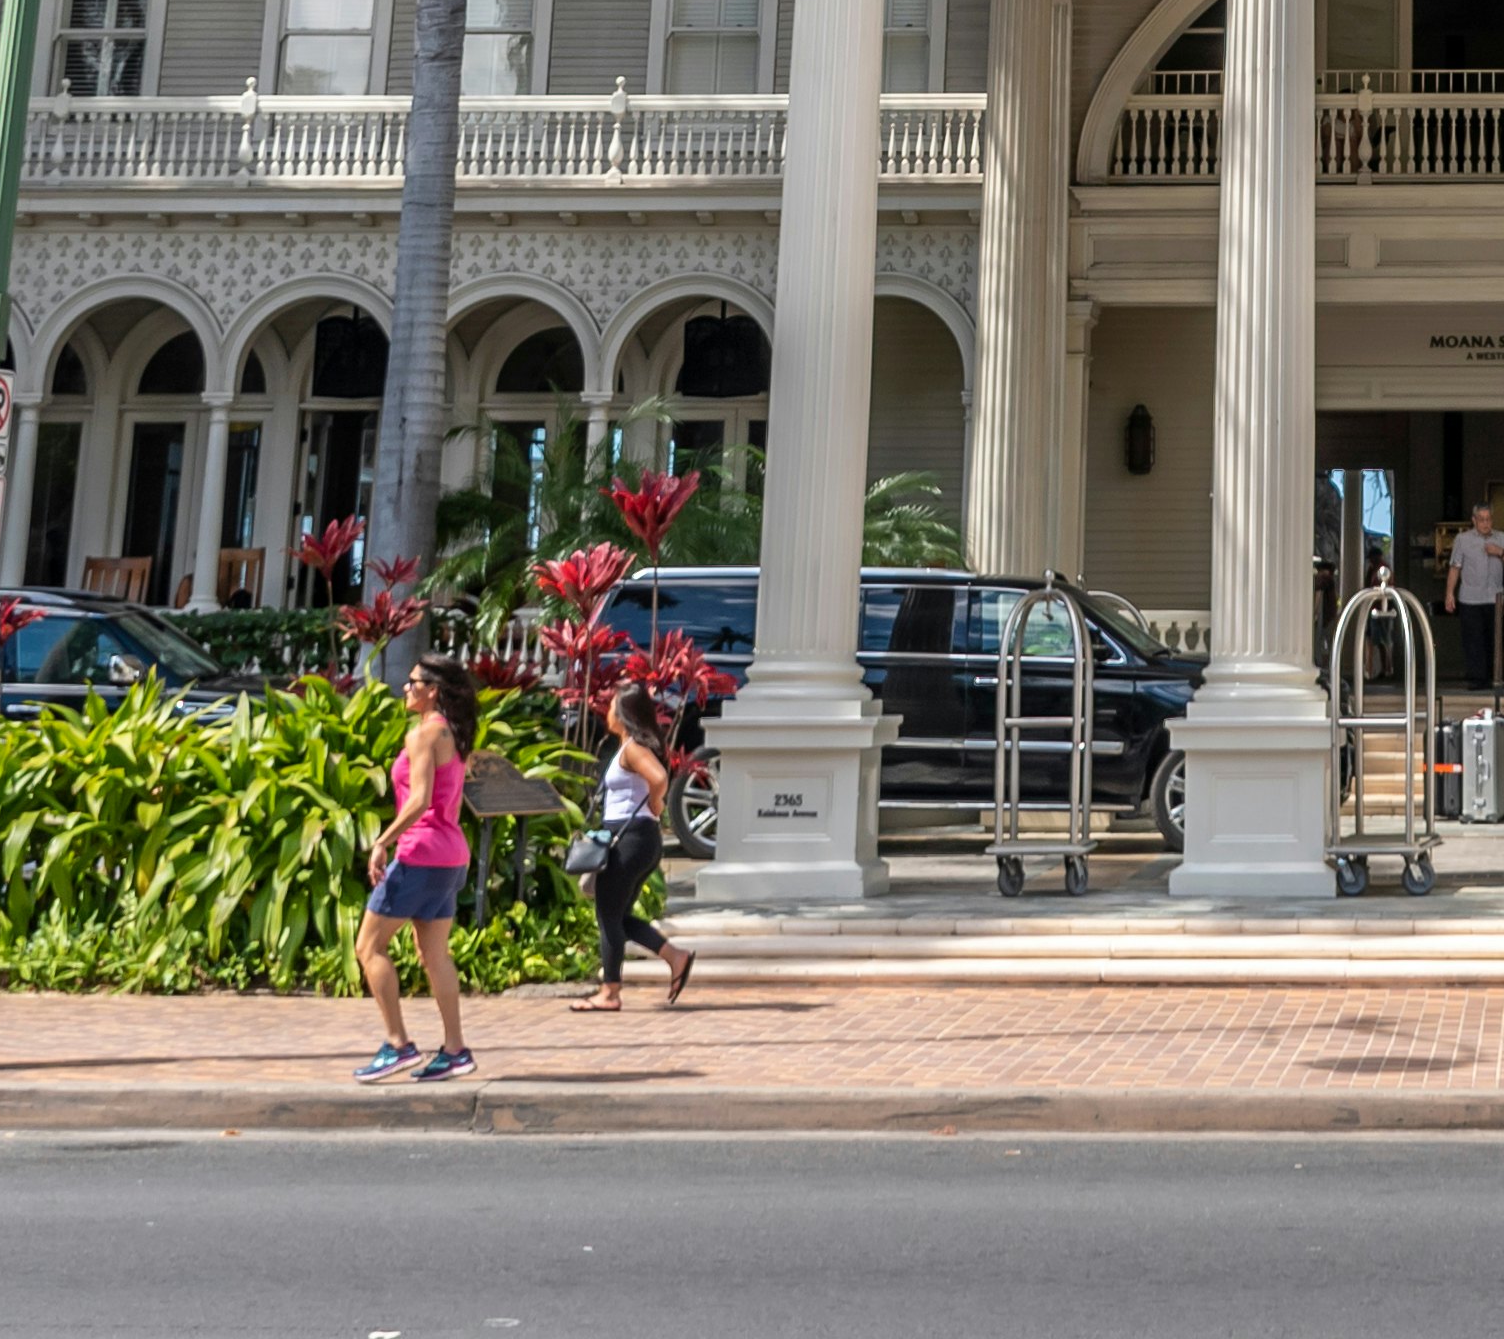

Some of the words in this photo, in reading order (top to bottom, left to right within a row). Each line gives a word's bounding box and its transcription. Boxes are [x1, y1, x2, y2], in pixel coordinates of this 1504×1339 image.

[1429, 335, 1495, 349] MOANA
[1466, 352, 1473, 360] A
[775, 793, 803, 807] 2365
